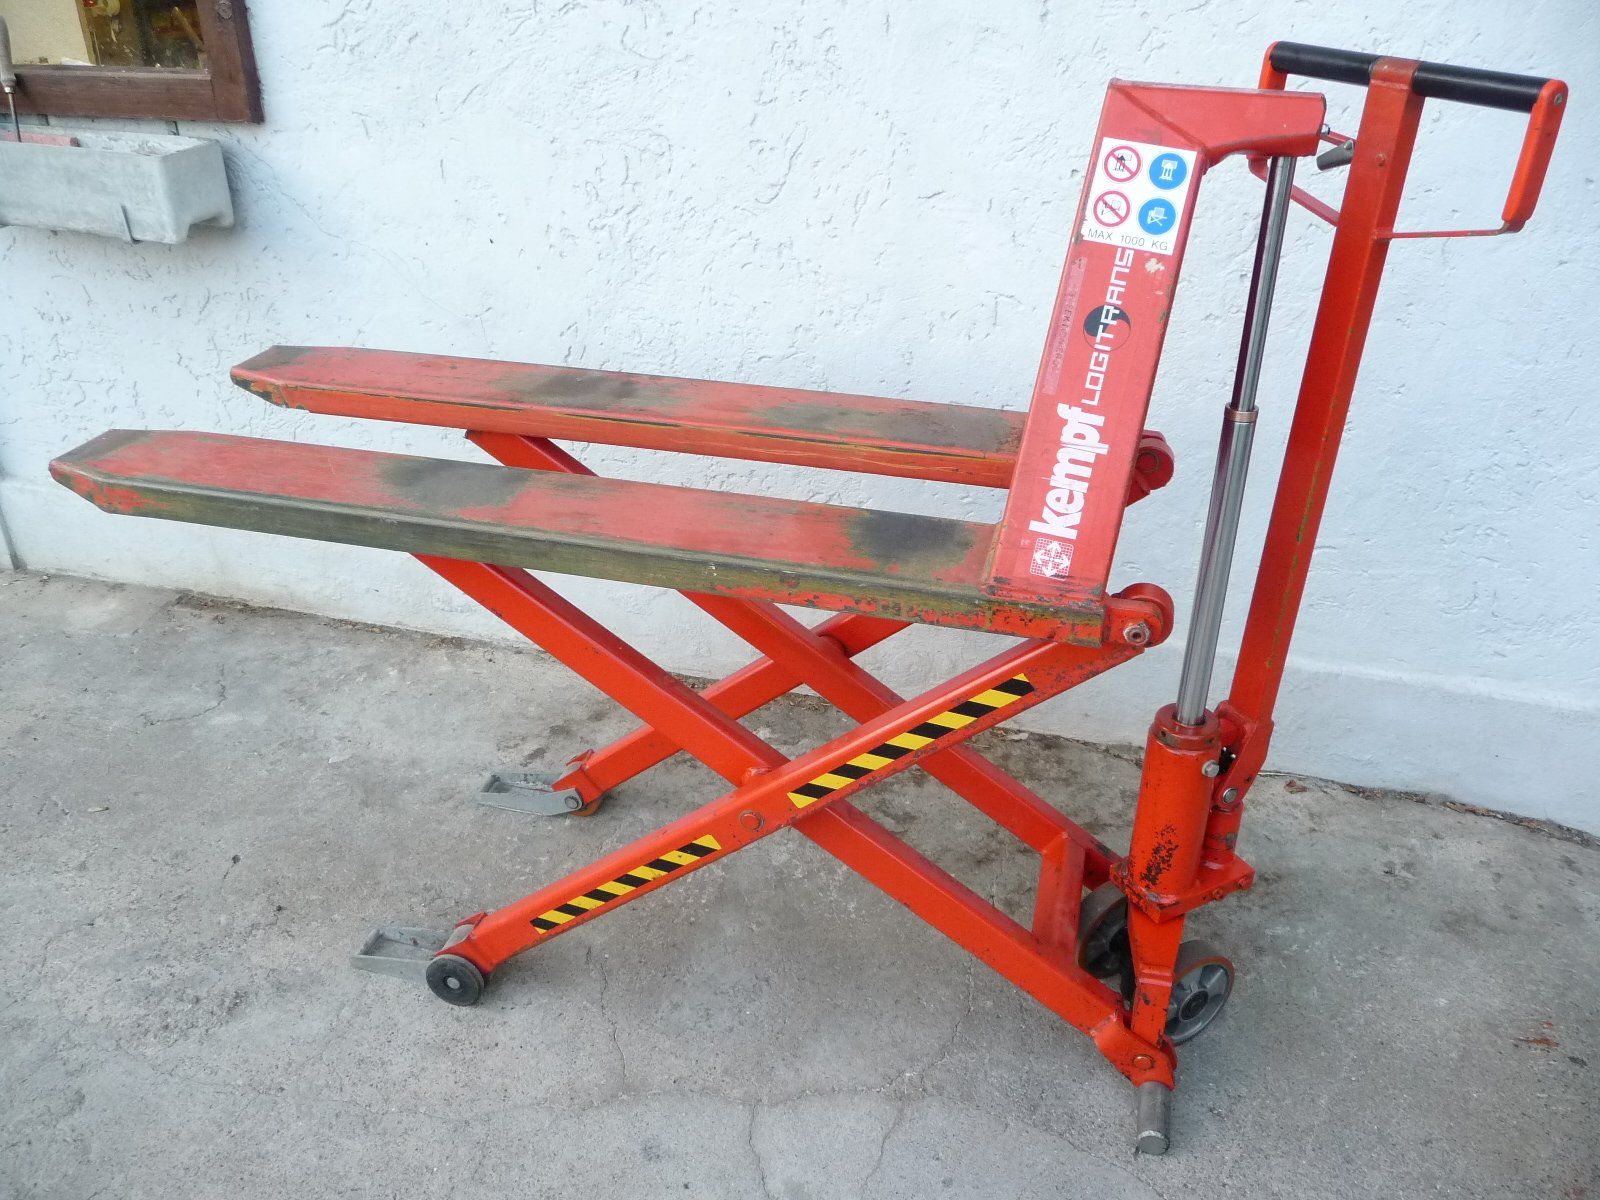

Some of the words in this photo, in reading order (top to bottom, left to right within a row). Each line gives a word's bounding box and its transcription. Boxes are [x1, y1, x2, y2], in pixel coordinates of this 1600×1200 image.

[1088, 228, 1113, 241] MAX
[1121, 235, 1146, 247] 1000
[1151, 240, 1168, 251] KG
[1028, 402, 1110, 540] kempf
[1080, 247, 1135, 407] LOGITRANS
